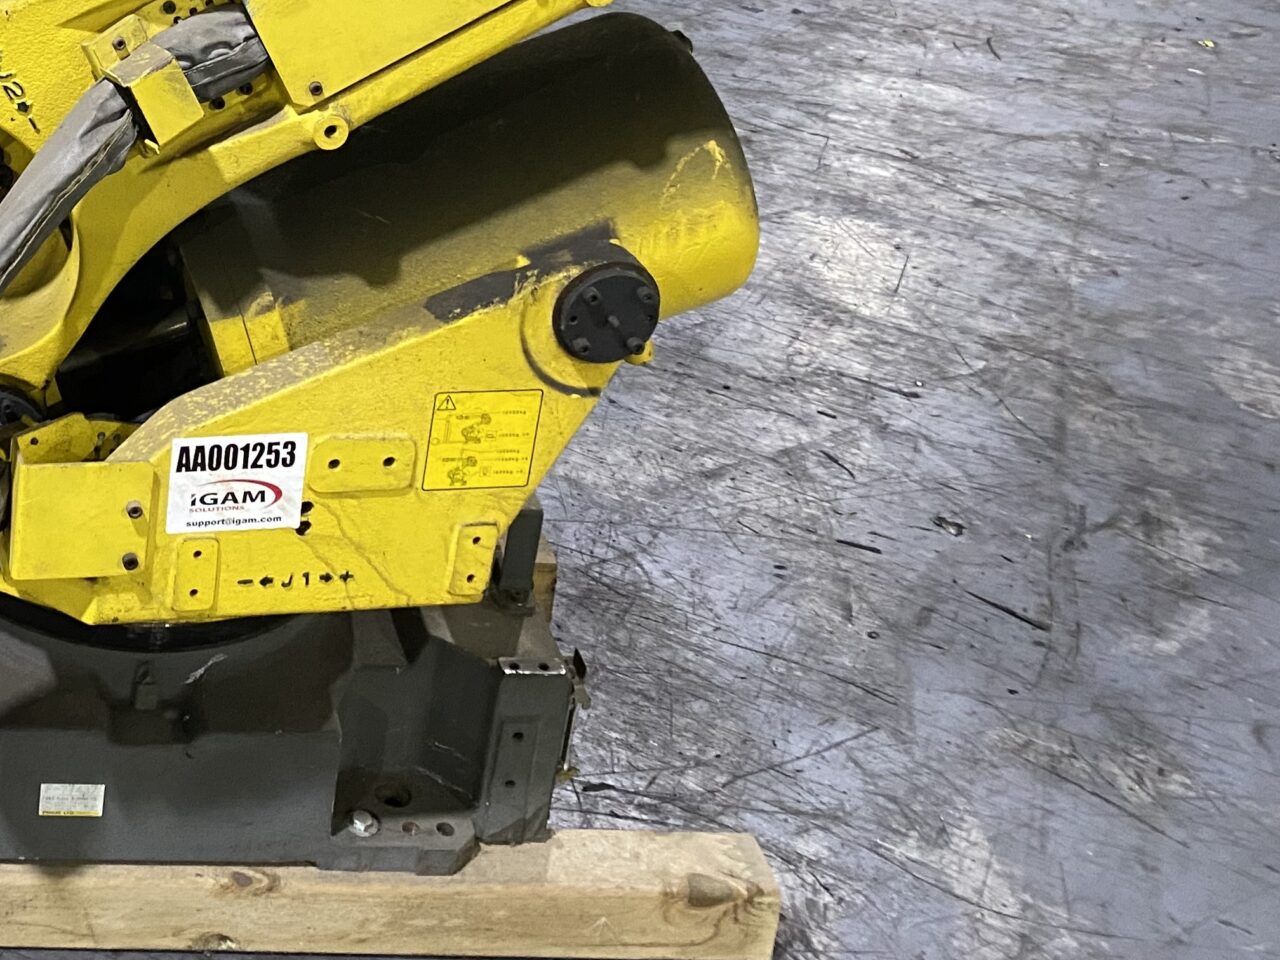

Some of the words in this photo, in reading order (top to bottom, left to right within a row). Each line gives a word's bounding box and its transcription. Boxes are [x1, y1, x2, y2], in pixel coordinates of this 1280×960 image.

[176, 441, 297, 472] AA001253
[188, 505, 246, 514] SOLUTIONS
[186, 515, 283, 528] support@igam.com
